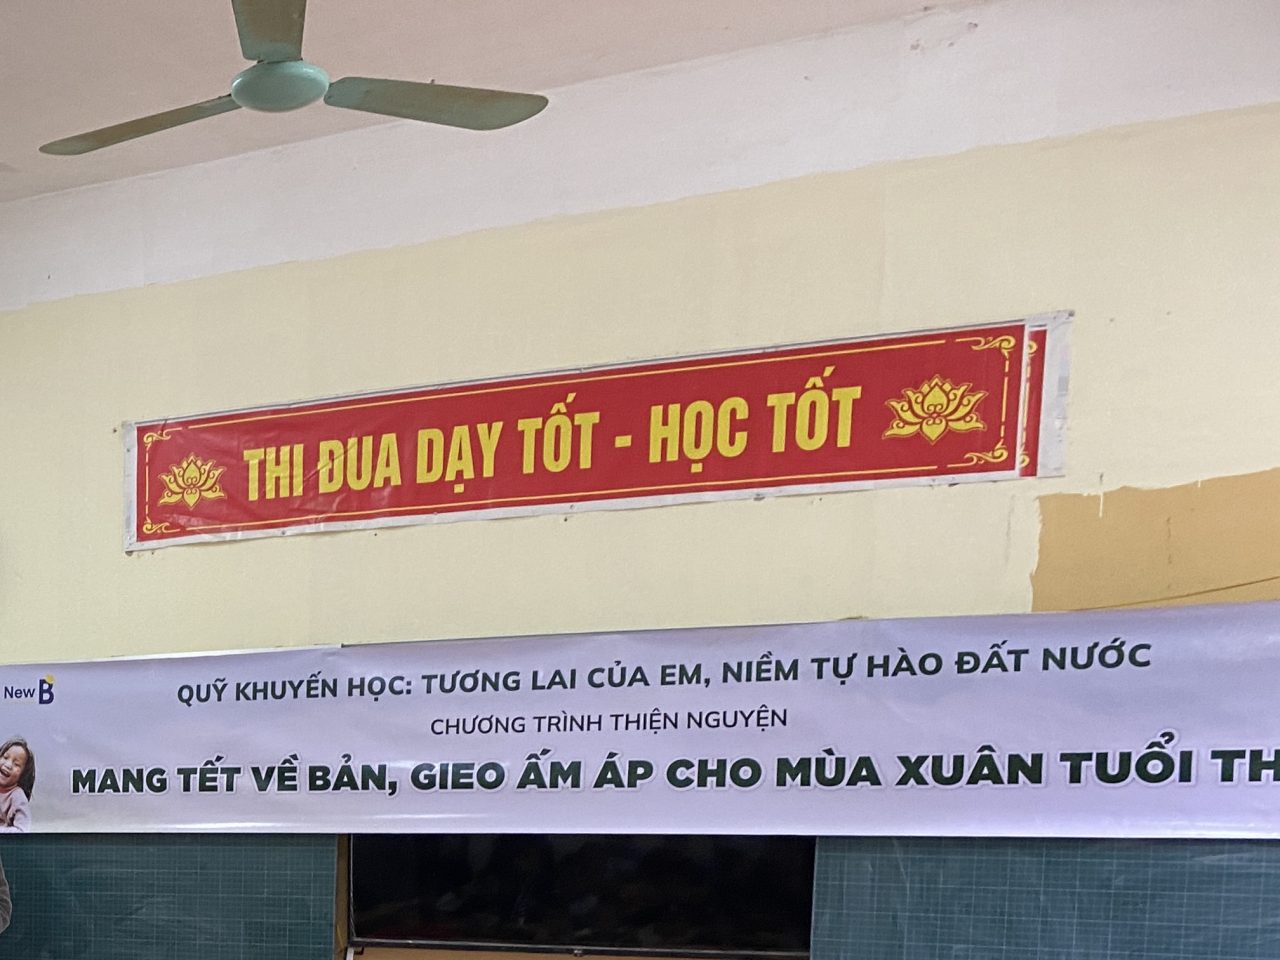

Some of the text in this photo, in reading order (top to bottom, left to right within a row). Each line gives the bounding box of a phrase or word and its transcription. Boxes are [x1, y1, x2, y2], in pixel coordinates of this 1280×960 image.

[243, 444, 304, 501] THI
[318, 434, 402, 494] ĐUA
[415, 421, 504, 494] DẠY
[517, 393, 600, 475] TỐT
[649, 396, 749, 473] HỌC
[767, 365, 862, 453] TỐT
[177, 638, 1152, 707] QUỸ KHUYẾN HỌC: TƯƠNG LAI CỦA EM, NIỀM TỰ HÀO ĐẤT NƯỚC
[430, 704, 788, 735] CHƯƠNG TRÌNH THIỆN NGUYỆN
[72, 767, 168, 794] MANG
[177, 755, 241, 792] TẾT
[251, 754, 298, 791] VỀ
[309, 754, 397, 796] BẢN,
[410, 763, 505, 791] GIEO
[518, 748, 581, 790] ẤM
[592, 753, 654, 790] ÁP
[666, 757, 762, 788] CHO
[776, 748, 882, 787] MÙA
[895, 745, 1043, 786] XUÂN
[1060, 731, 1193, 784] TUỔI
